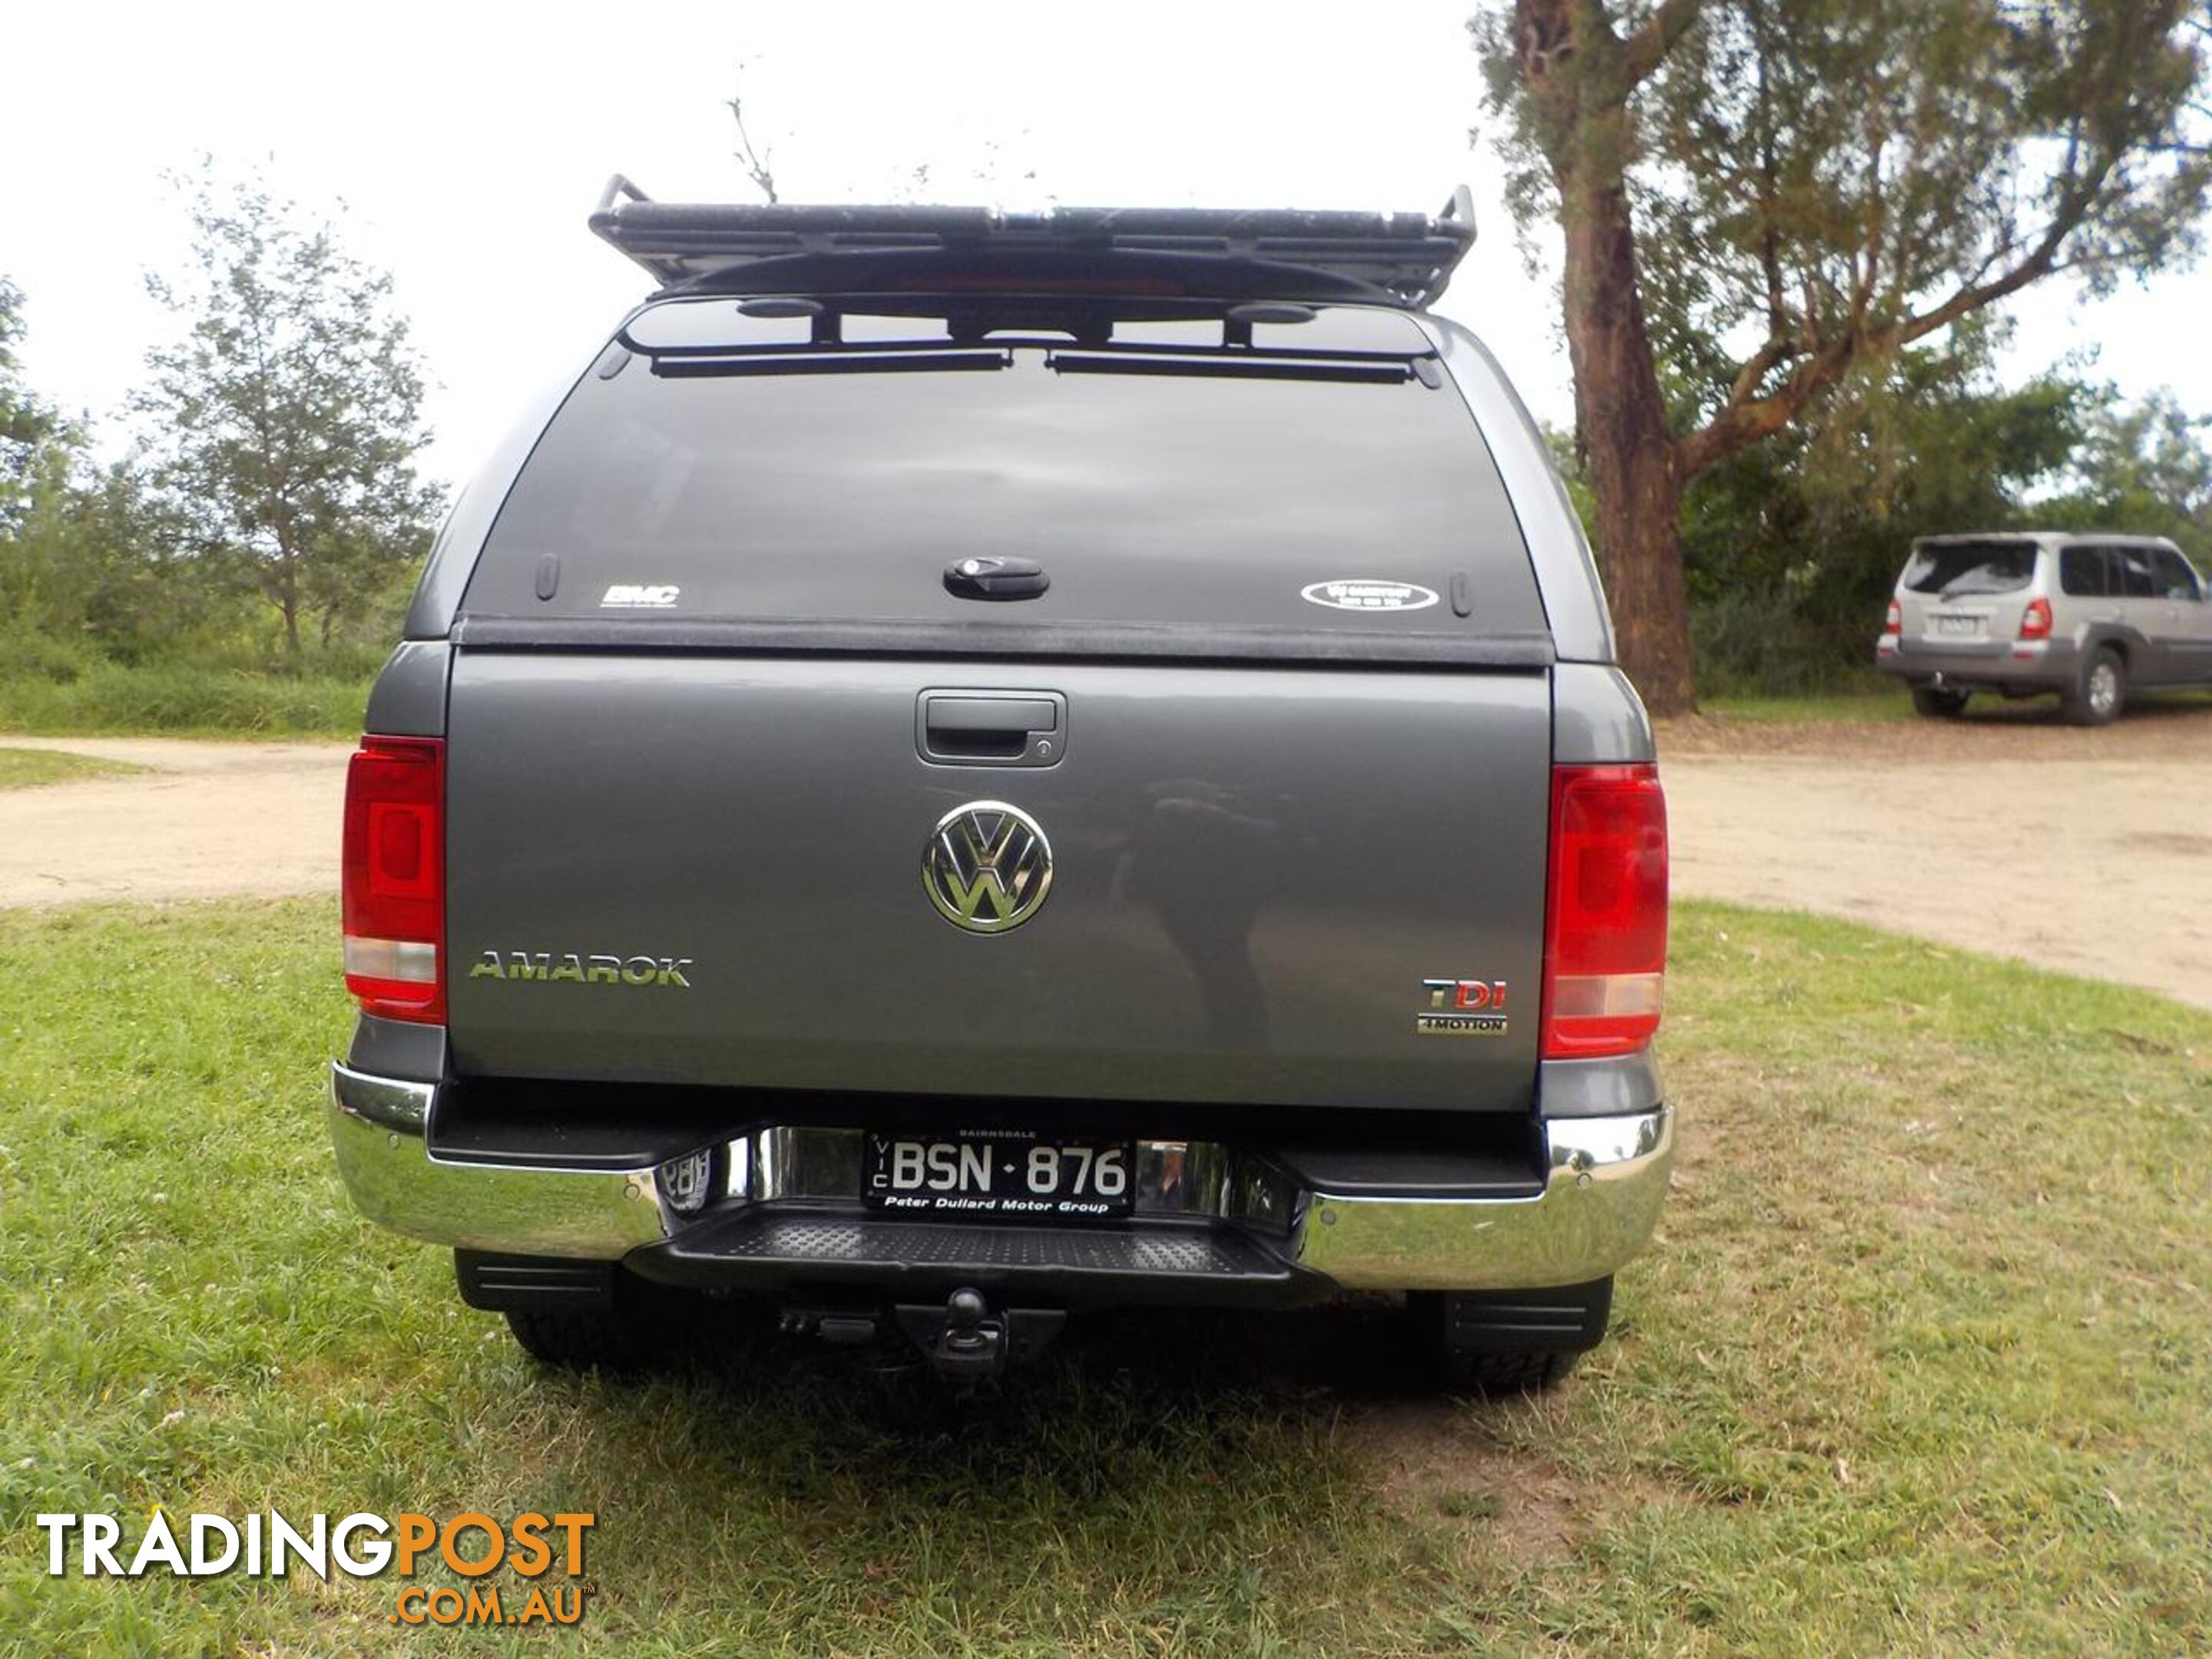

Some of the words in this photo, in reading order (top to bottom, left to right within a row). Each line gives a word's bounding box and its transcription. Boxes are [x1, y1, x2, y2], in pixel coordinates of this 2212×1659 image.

[469, 952, 692, 987] AMAROK
[1423, 979, 1506, 1008] TDI
[1422, 1018, 1503, 1031] 4MOTION
[959, 1129, 1037, 1138] BAIRNSDALE
[873, 1141, 889, 1188] VIC
[892, 1141, 992, 1192] BSN
[1027, 1146, 1126, 1196] 876
[885, 1196, 929, 1207] Peter
[935, 1197, 996, 1210] Dullard
[1002, 1199, 1052, 1211] Motor
[1058, 1201, 1108, 1214] Group
